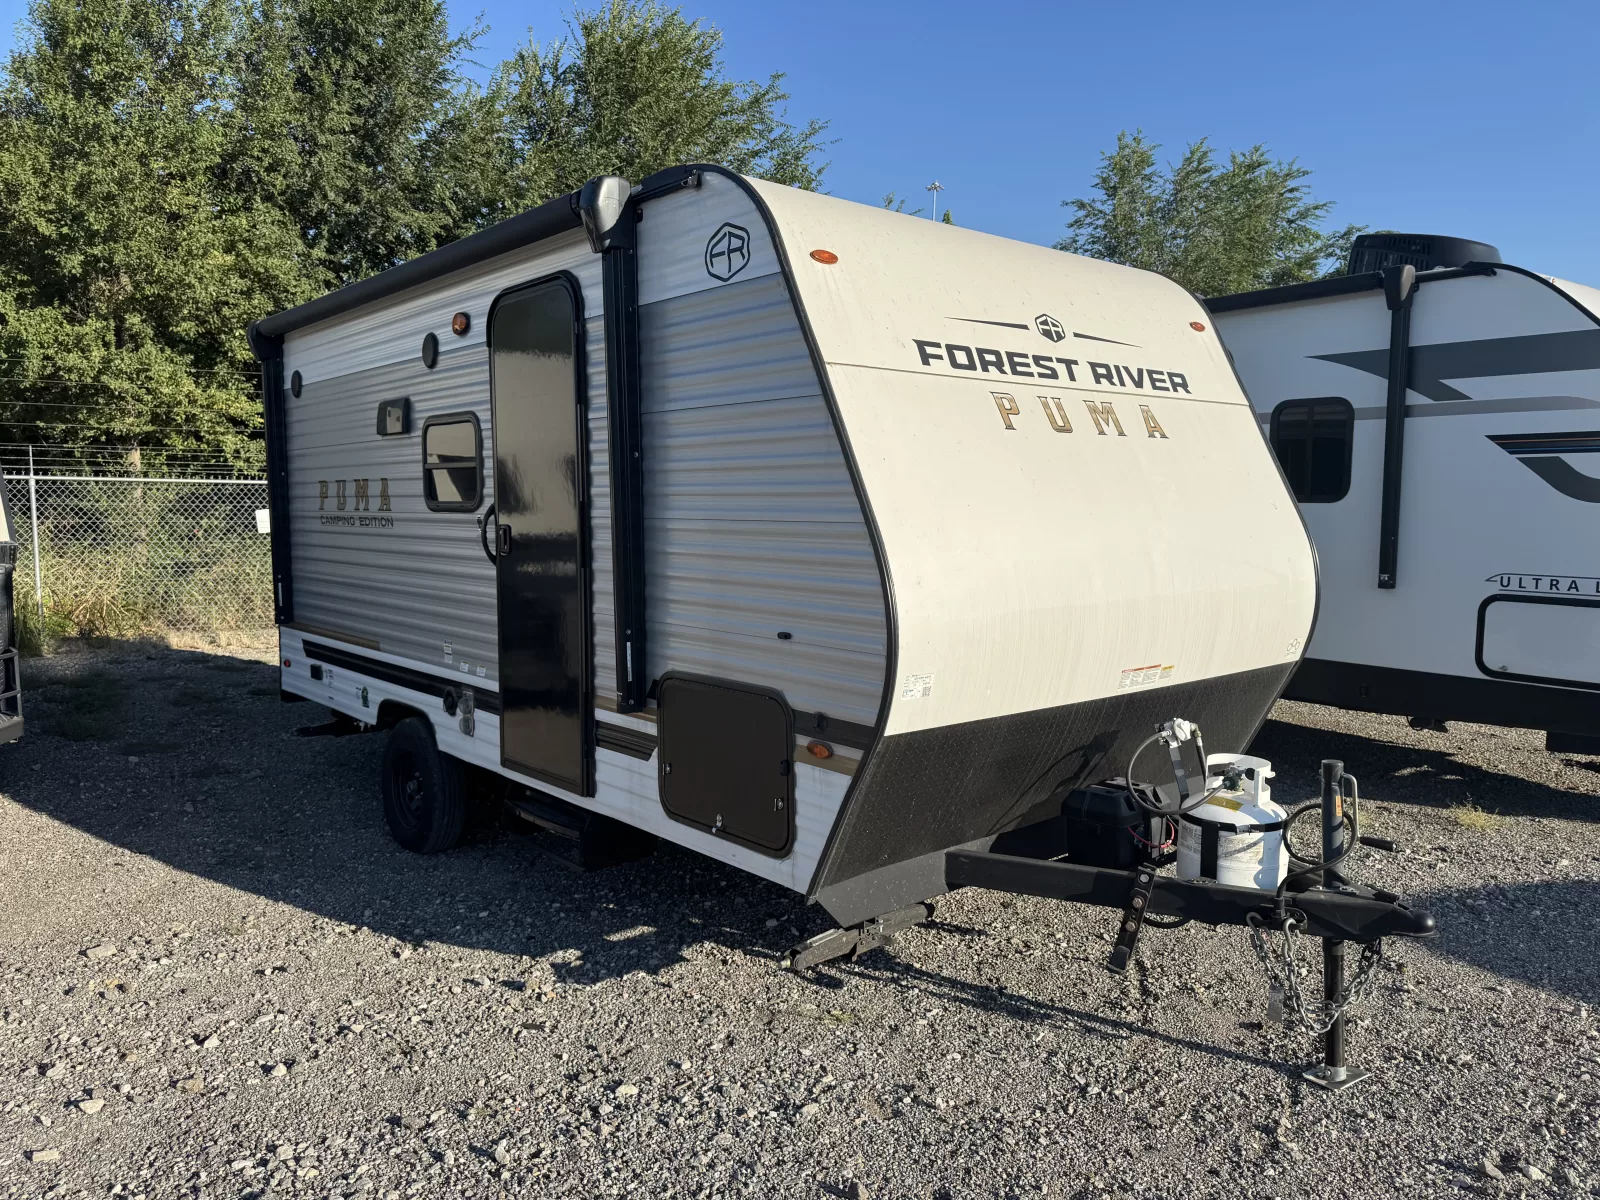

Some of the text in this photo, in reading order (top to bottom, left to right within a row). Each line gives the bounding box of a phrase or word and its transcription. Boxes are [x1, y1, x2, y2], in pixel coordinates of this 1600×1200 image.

[911, 339, 1192, 394] FOREST RIVER
[989, 390, 1170, 439] PUMA
[318, 478, 392, 511] PUMA
[320, 515, 394, 528] CAMPING EDITION
[1500, 575, 1580, 592] ULTRA
